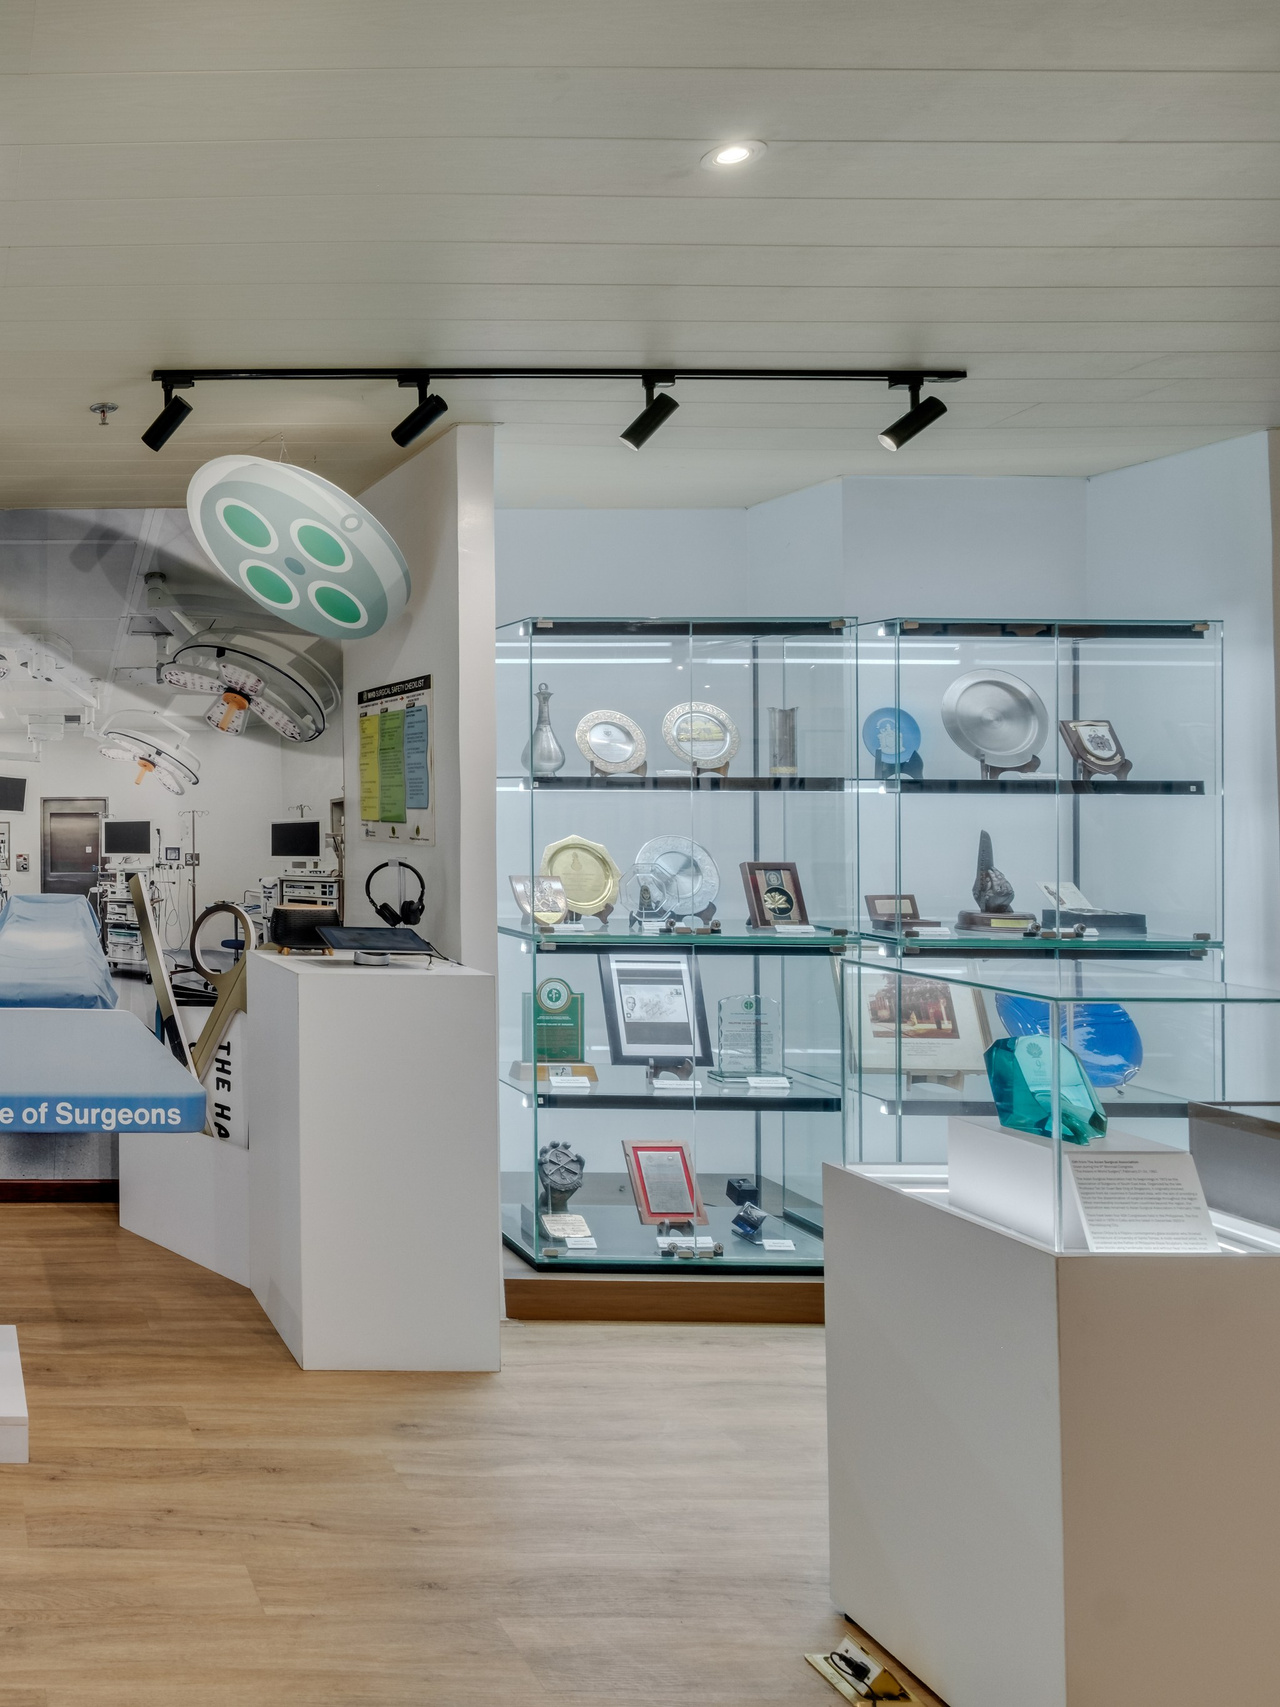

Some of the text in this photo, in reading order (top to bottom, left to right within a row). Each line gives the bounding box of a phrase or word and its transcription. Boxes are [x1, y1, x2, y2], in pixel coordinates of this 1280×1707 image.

[367, 679, 425, 700] WHO SURGICAL SAFETY CHECKLIST
[215, 1041, 232, 1092] THE
[22, 1102, 48, 1124] of
[55, 1102, 182, 1131] Surgeons
